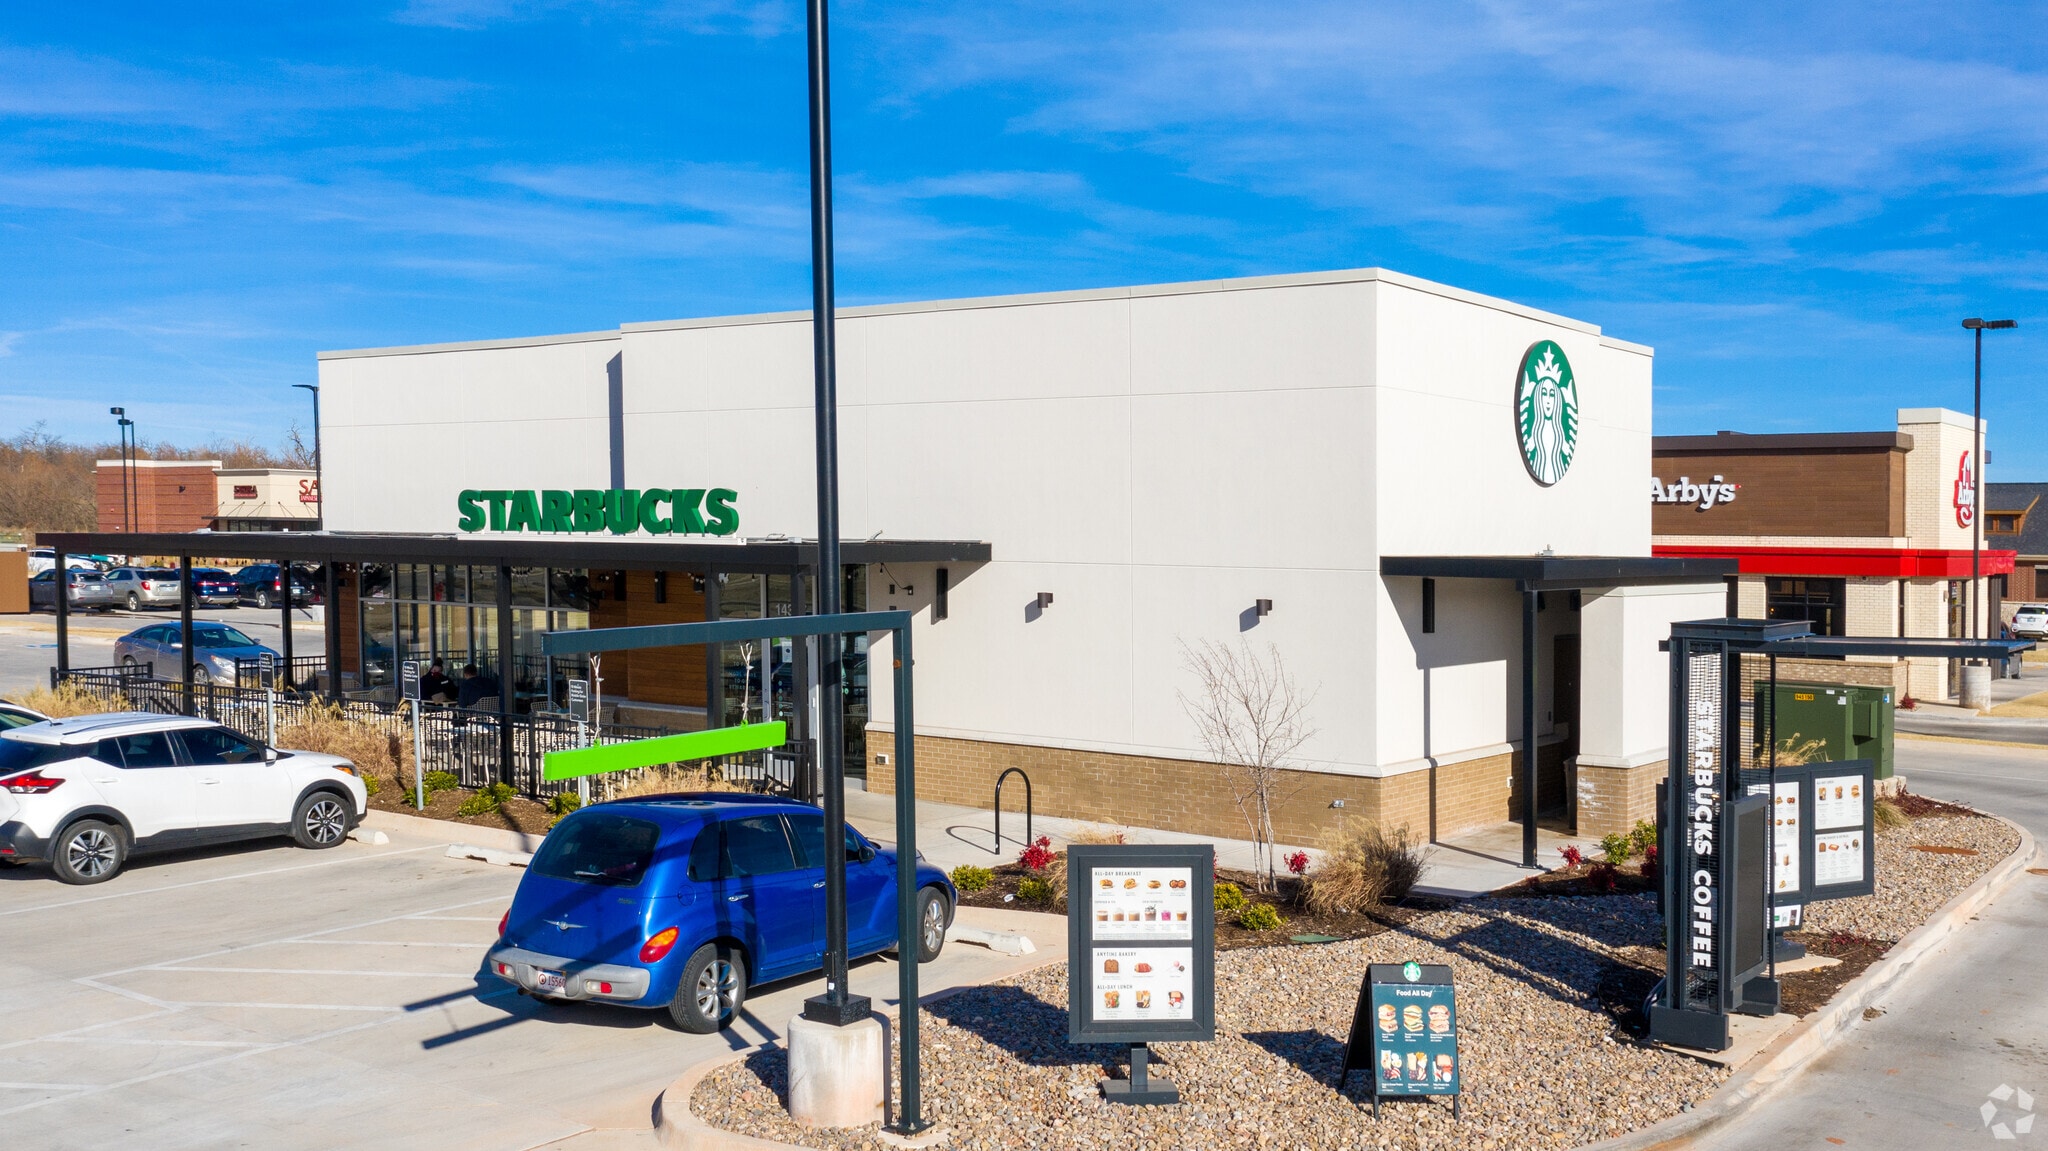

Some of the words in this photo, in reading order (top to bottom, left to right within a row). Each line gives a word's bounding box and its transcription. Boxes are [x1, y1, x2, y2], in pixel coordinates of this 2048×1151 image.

[458, 488, 740, 536] STARBUCKS
[1651, 475, 1736, 510] Arby's
[1693, 700, 1713, 855] STARBUCKS
[1693, 869, 1712, 967] COFFEE
